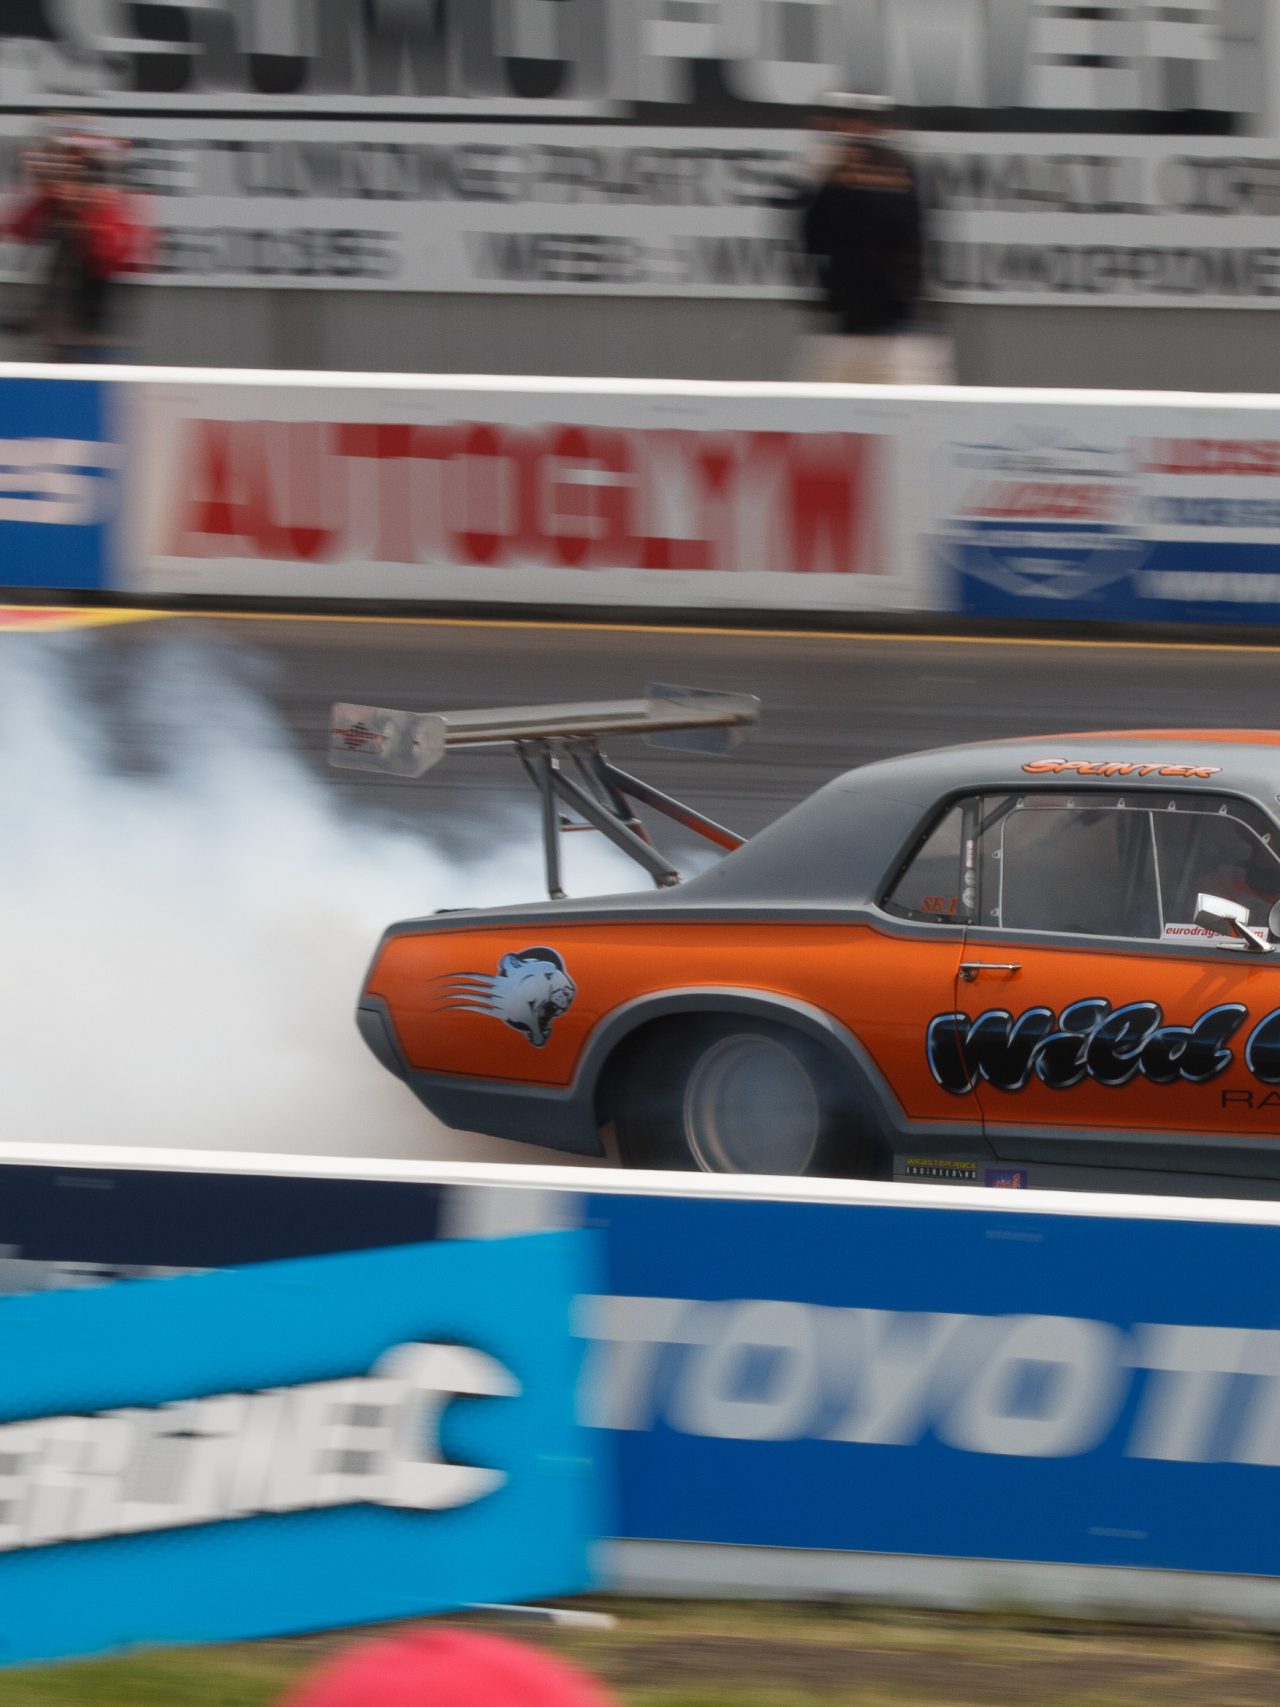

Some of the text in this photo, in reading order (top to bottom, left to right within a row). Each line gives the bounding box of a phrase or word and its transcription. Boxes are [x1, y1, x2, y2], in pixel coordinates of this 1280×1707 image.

[168, 417, 890, 576] AUTOGLYM
[1021, 758, 1223, 778] SPLINTER
[924, 996, 1249, 1095] Wild
[578, 1293, 1125, 1458] TOYO
